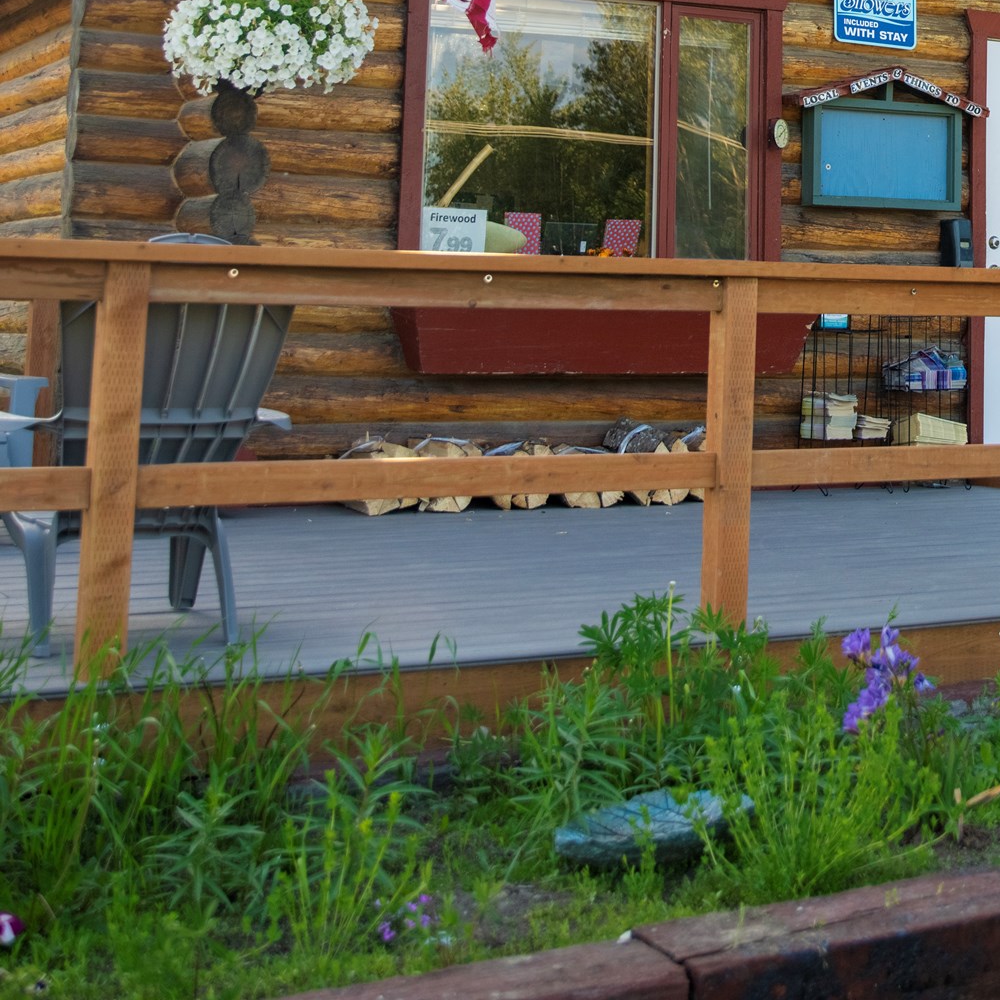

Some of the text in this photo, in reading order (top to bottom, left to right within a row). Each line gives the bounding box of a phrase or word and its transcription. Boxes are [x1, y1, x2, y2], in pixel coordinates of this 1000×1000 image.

[843, 18, 879, 29] INCLUDED
[844, 26, 909, 43] WITH STAY
[803, 68, 982, 116] LOCAL EVENTS & THINGS TO DO
[430, 212, 476, 223] Firewood
